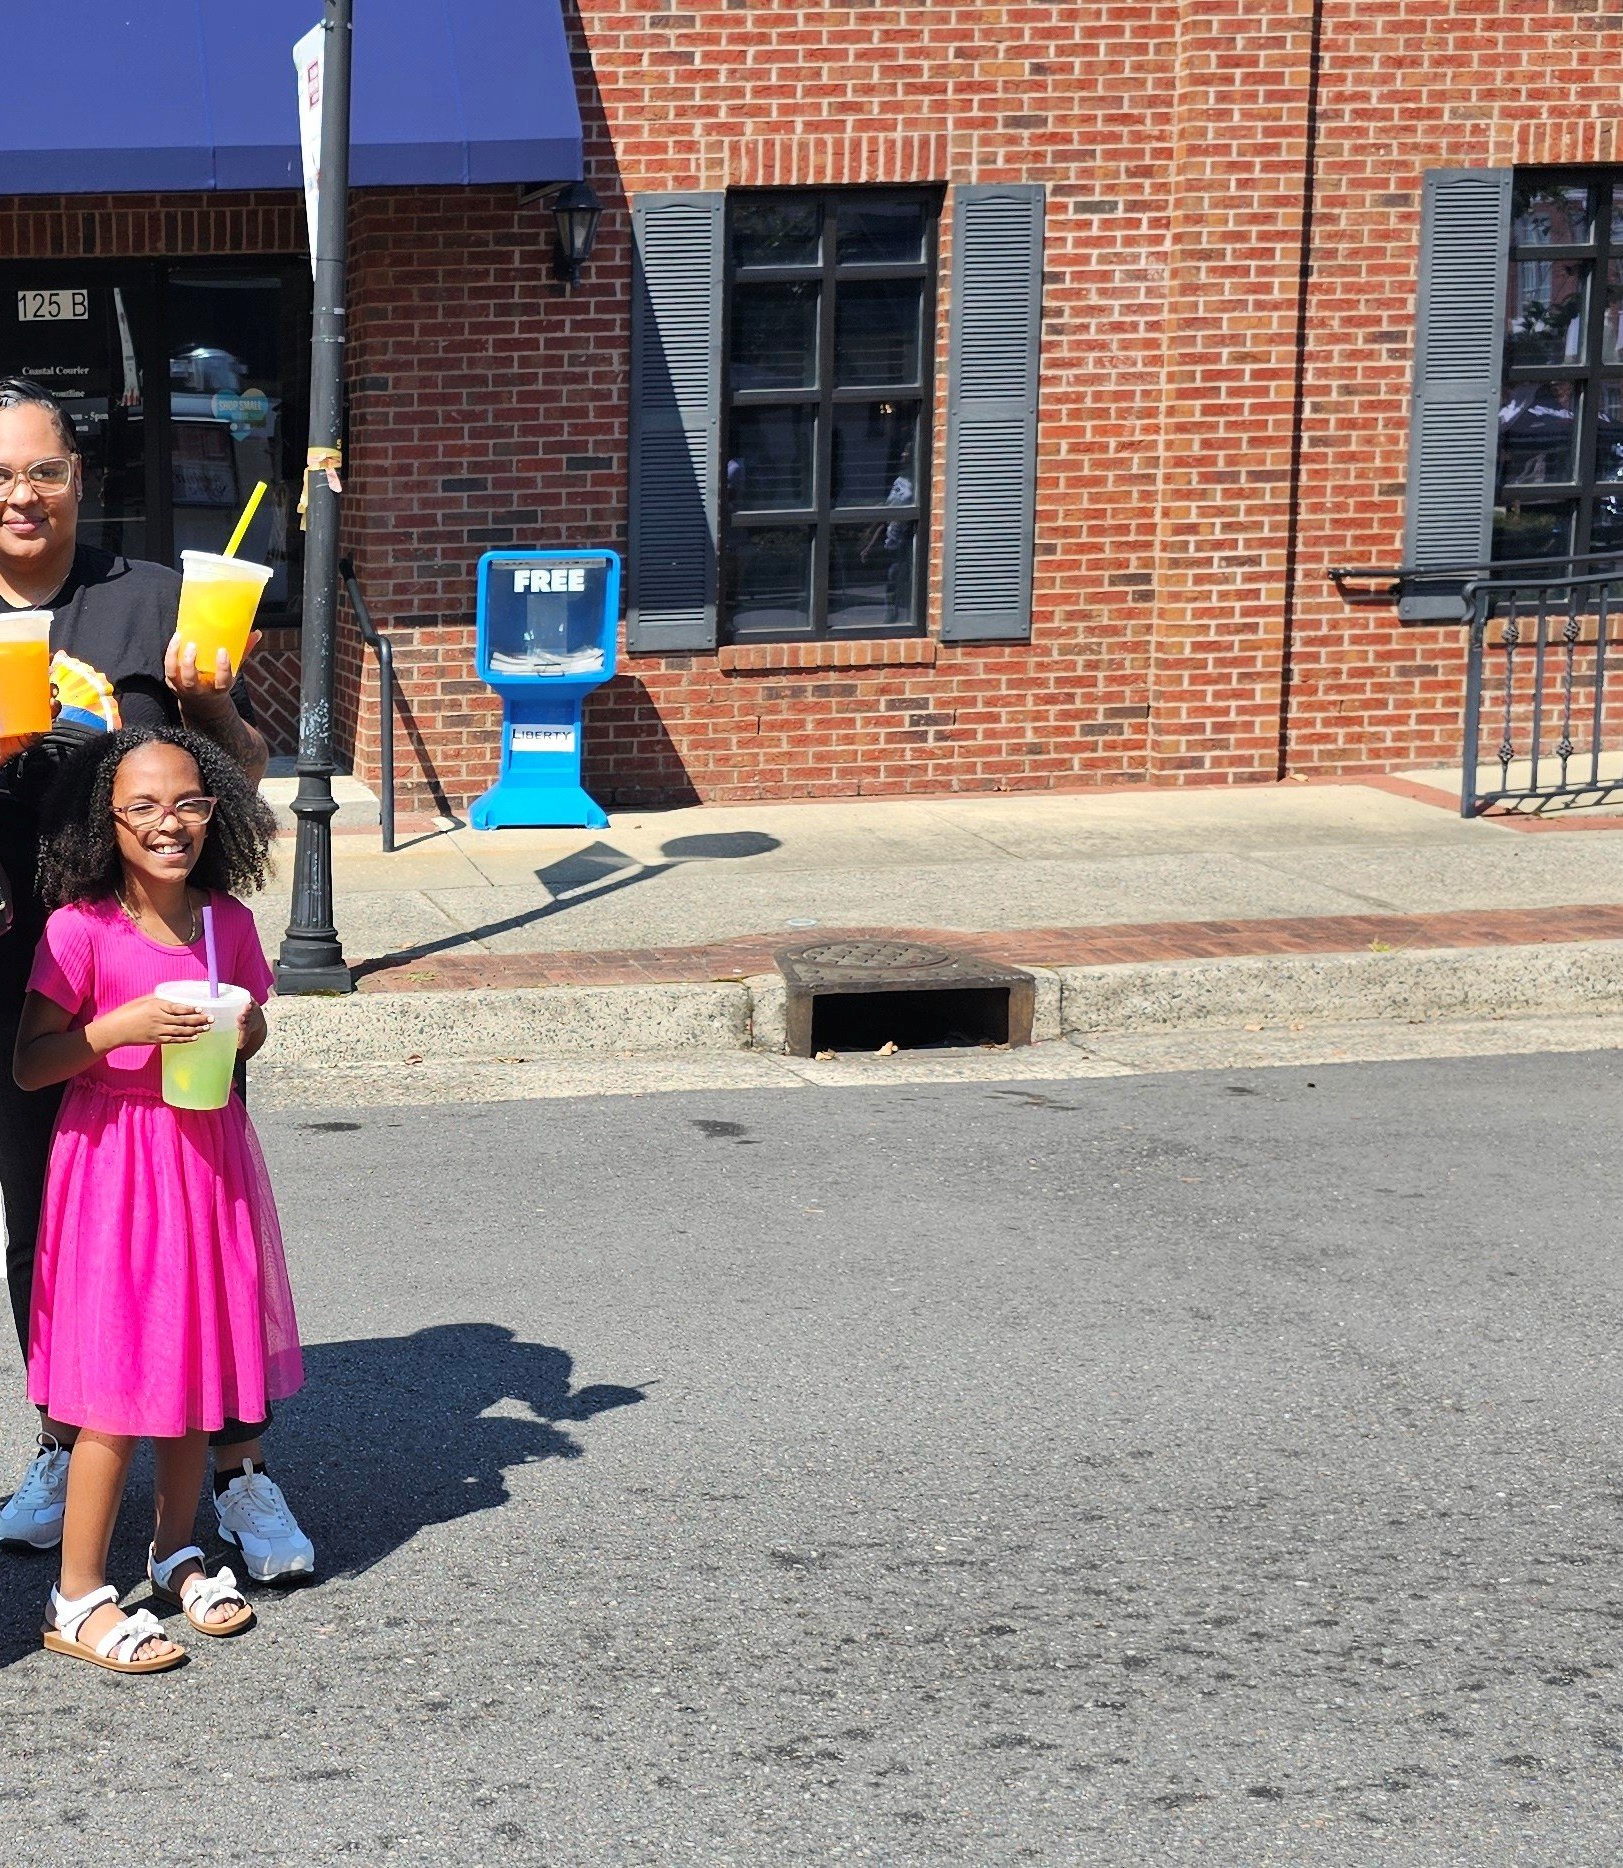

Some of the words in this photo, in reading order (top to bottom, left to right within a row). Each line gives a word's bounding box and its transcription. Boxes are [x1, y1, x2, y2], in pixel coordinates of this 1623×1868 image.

[18, 293, 61, 319] 125
[71, 292, 87, 317] B
[22, 366, 54, 375] Coastal
[56, 366, 89, 375] Courier
[513, 568, 585, 593] FREE
